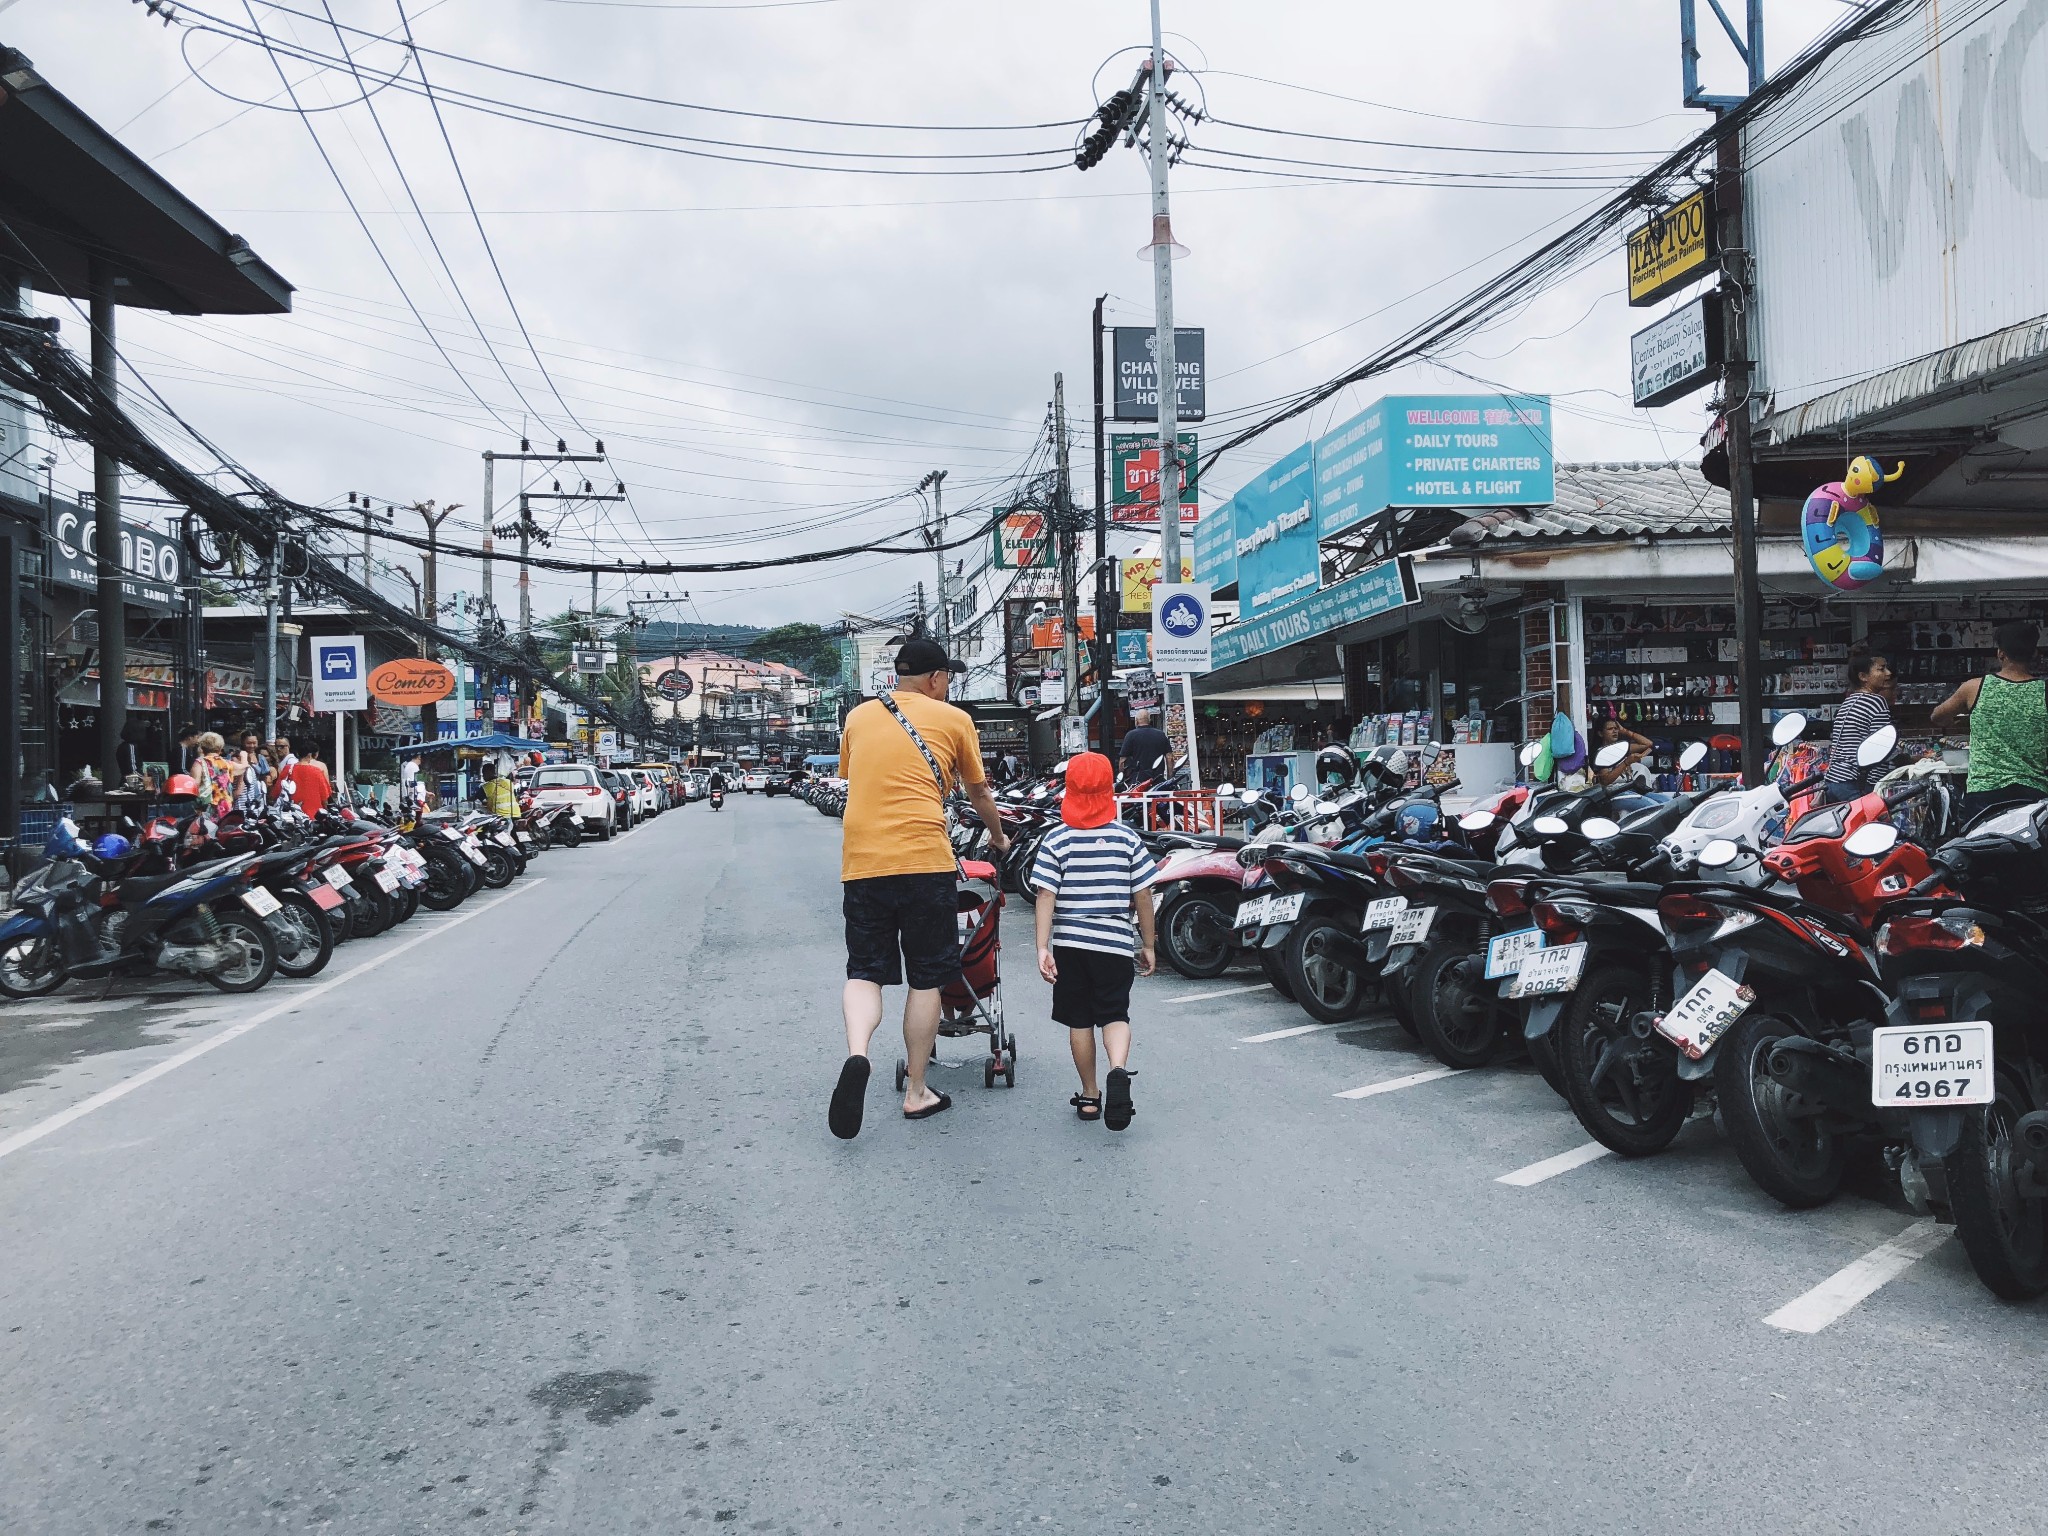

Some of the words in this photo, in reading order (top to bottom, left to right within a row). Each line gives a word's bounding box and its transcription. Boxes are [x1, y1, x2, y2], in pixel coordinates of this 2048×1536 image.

[1679, 237, 1704, 260] Painting
[1634, 346, 1656, 366] Center
[1657, 331, 1681, 354] Beauty
[1682, 319, 1703, 340] Salon
[1121, 361, 1200, 375] CHAENG
[1121, 377, 1200, 390] VILLEE
[1136, 391, 1187, 405] HOL
[1366, 412, 1381, 433] PARK
[1407, 410, 1479, 425] WELLCOME
[1188, 435, 1196, 446] 2
[1414, 434, 1451, 448] DAILY
[1455, 433, 1498, 448] TOURS
[1415, 457, 1469, 472] PRIVATE
[1472, 457, 1541, 472] CHARTERS
[1415, 481, 1458, 495] HOTEL
[1462, 481, 1472, 495] &
[1475, 481, 1521, 495] FLIGHT
[1124, 562, 1149, 580] MR.
[1152, 558, 1192, 578] CB
[121, 582, 137, 596] TEL
[1130, 591, 1153, 600] REST
[1239, 629, 1270, 655] DAILY
[1270, 609, 1311, 644] TOURS
[376, 671, 435, 692] Combo
[436, 675, 446, 689] 3
[1371, 917, 1395, 929] 622
[1524, 976, 1567, 992] 9065
[1676, 986, 1712, 1021] 1กก
[1903, 1034, 1962, 1054] 6กอ
[1884, 1058, 1983, 1078] กรุงเทพมหานคร
[1895, 1078, 1971, 1099] 4967
